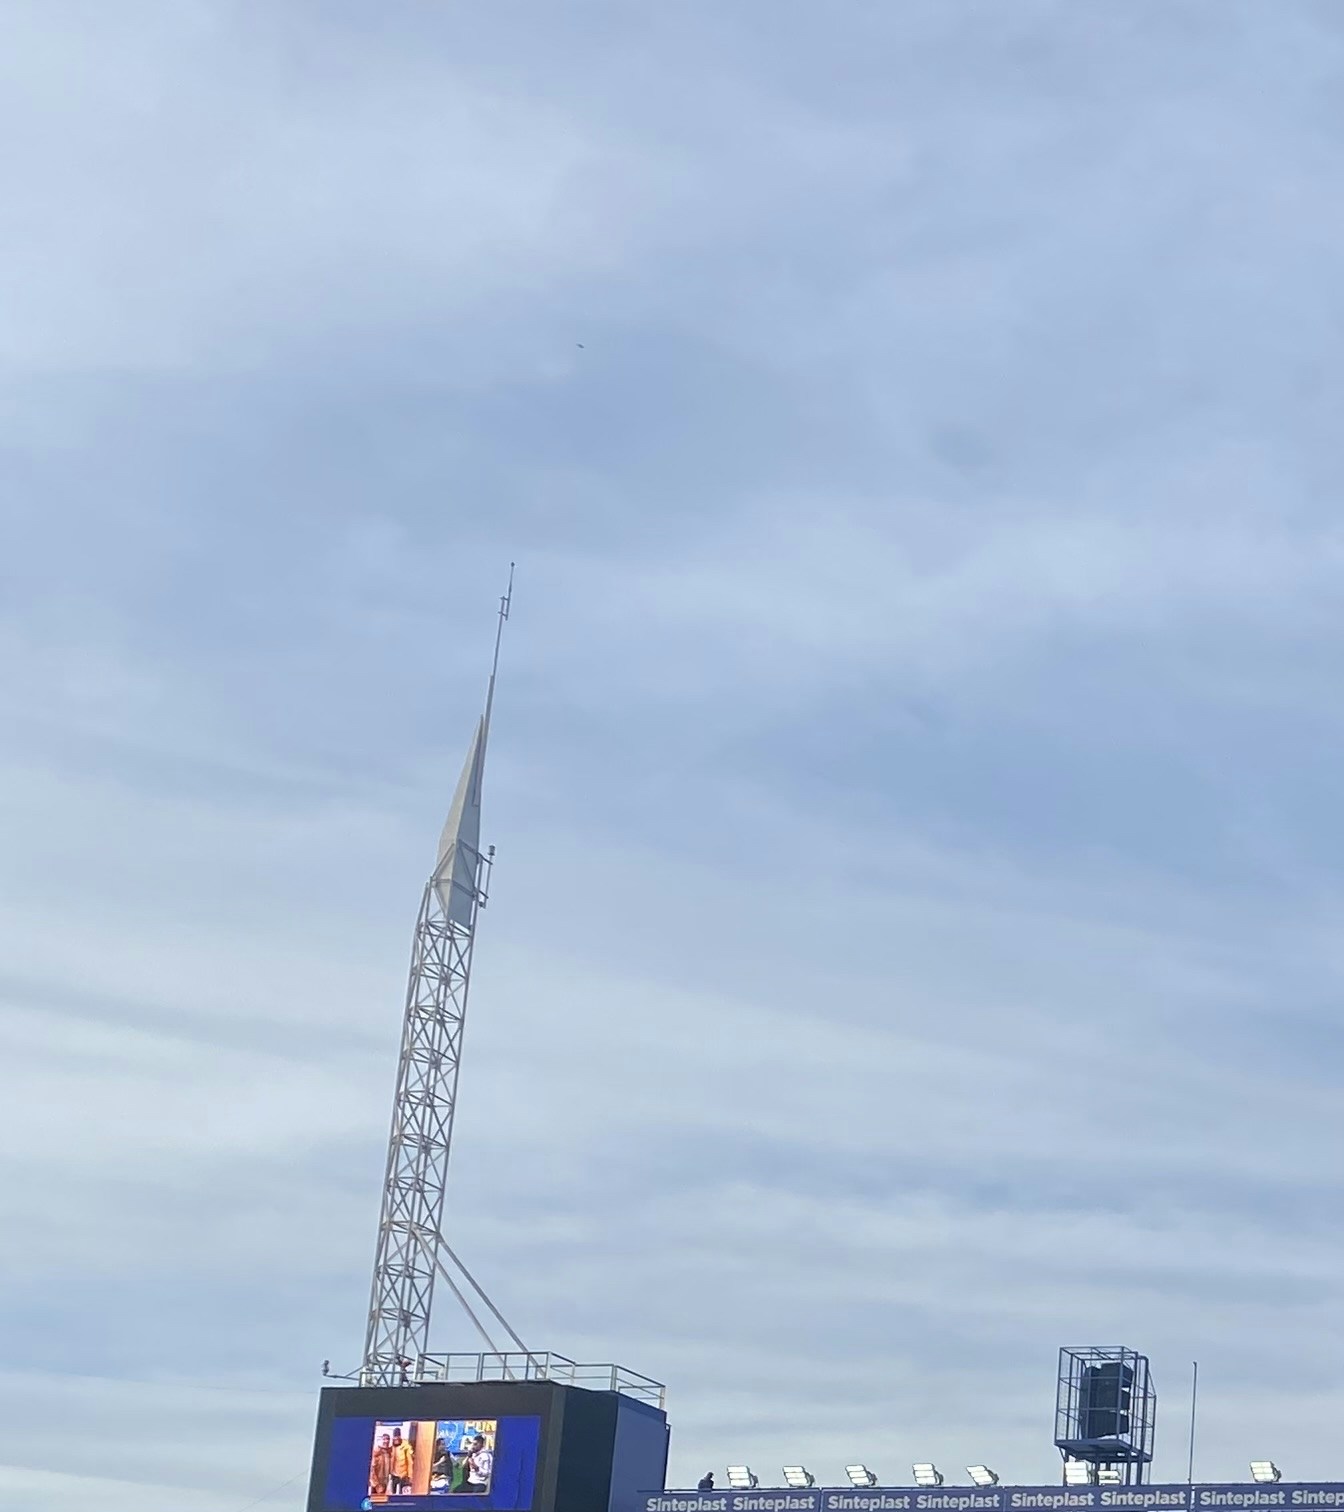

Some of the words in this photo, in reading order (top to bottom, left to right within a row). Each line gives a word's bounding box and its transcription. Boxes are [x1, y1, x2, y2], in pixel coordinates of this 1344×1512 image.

[733, 1495, 815, 1512] Sinteplast
[828, 1495, 910, 1511] Sinteplast
[916, 1493, 1000, 1510] Sinteplast
[1011, 1492, 1095, 1508] Sinteplast
[1100, 1490, 1186, 1507] Sinteplast
[1200, 1490, 1285, 1507] Sinteplast
